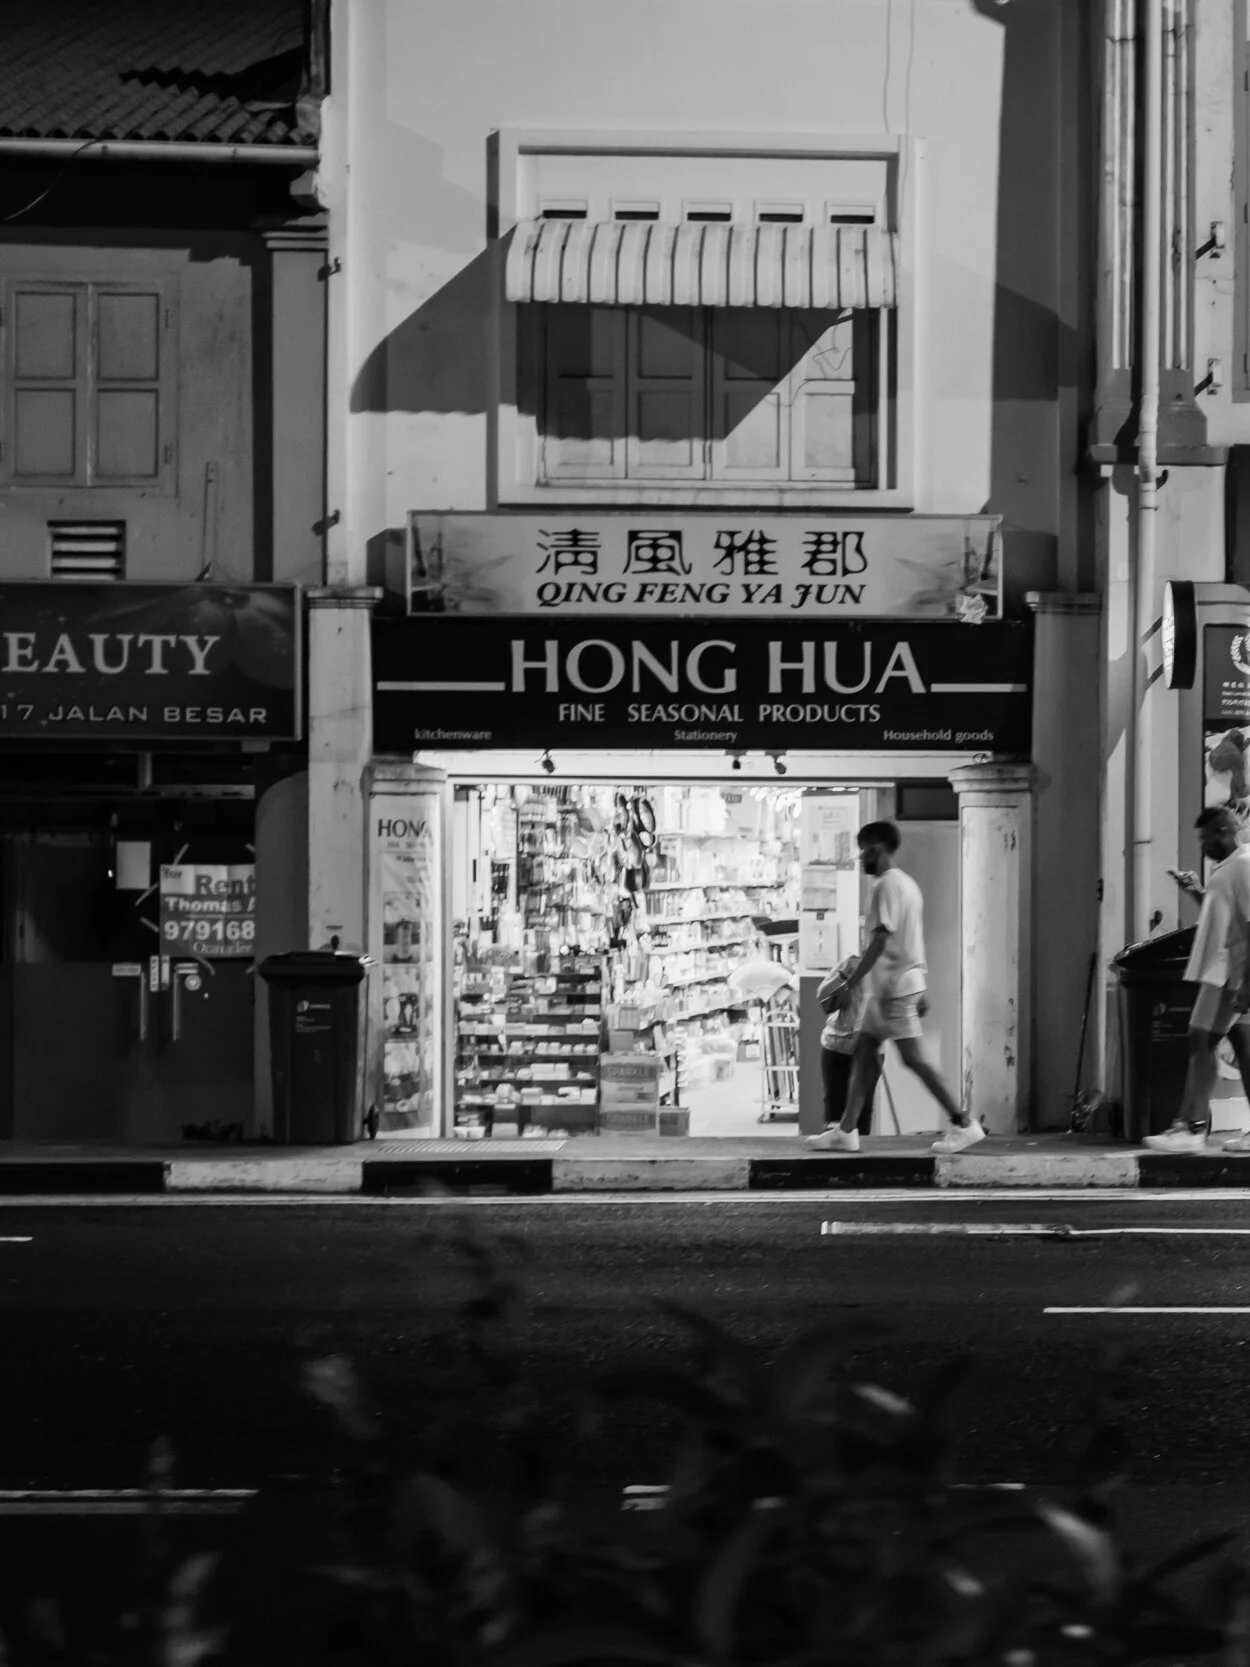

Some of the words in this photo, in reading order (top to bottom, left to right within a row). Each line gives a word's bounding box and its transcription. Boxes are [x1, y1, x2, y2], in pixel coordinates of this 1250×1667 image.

[536, 582, 627, 605] QING
[633, 582, 731, 604] FENG
[741, 583, 783, 604] YA
[791, 583, 866, 608] JUN
[1, 632, 221, 676] EAUTY
[510, 638, 737, 695] HONG
[768, 640, 927, 694] HUA
[49, 706, 148, 722] JALAN
[163, 707, 267, 723] BESAR
[559, 704, 606, 722] FINE
[627, 704, 745, 723] SEASONAL
[758, 704, 882, 723] PRODUCTS
[414, 728, 493, 740] kitchenware
[673, 729, 738, 743] Stationery
[883, 729, 951, 741] Household
[955, 730, 994, 744] goods
[195, 874, 255, 896] Rent
[164, 896, 243, 913] Thomas
[163, 920, 255, 941] 979168
